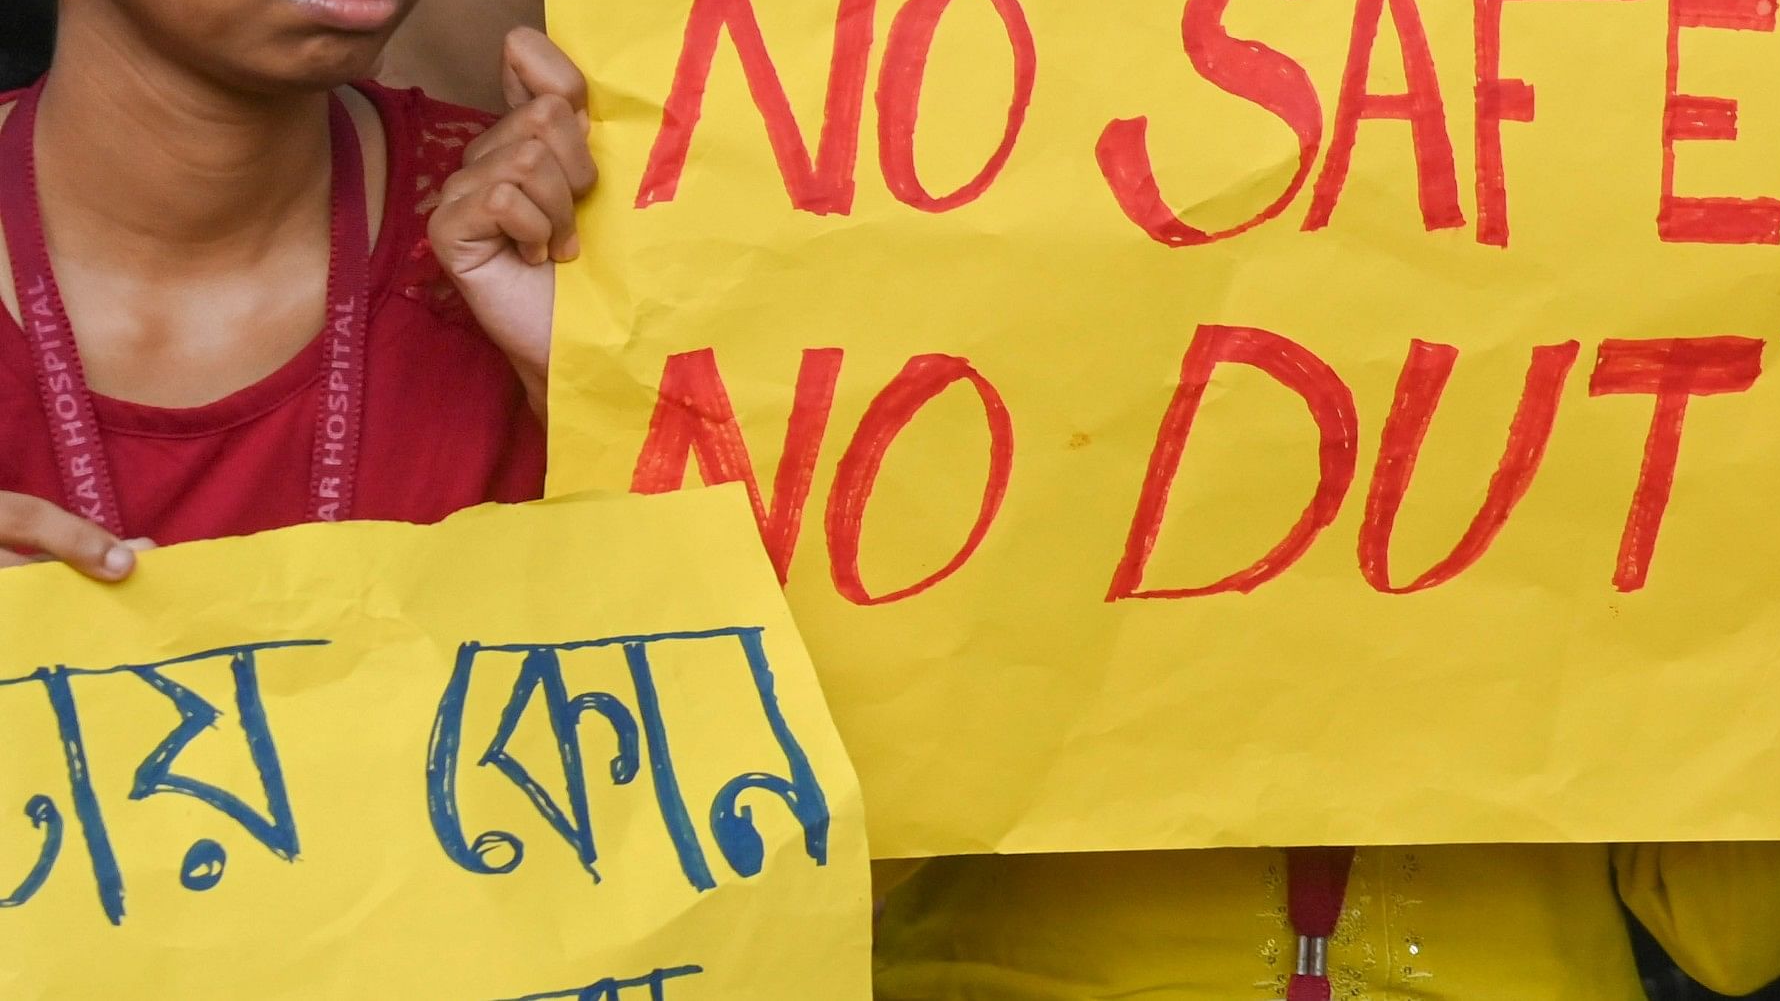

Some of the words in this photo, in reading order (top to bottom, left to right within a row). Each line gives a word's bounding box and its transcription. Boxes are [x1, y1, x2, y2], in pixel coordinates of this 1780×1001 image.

[28, 275, 87, 447] HOSPITAL
[322, 295, 355, 465] HOSPITAL
[630, 348, 1013, 606] NO
[427, 626, 829, 892] কোন
